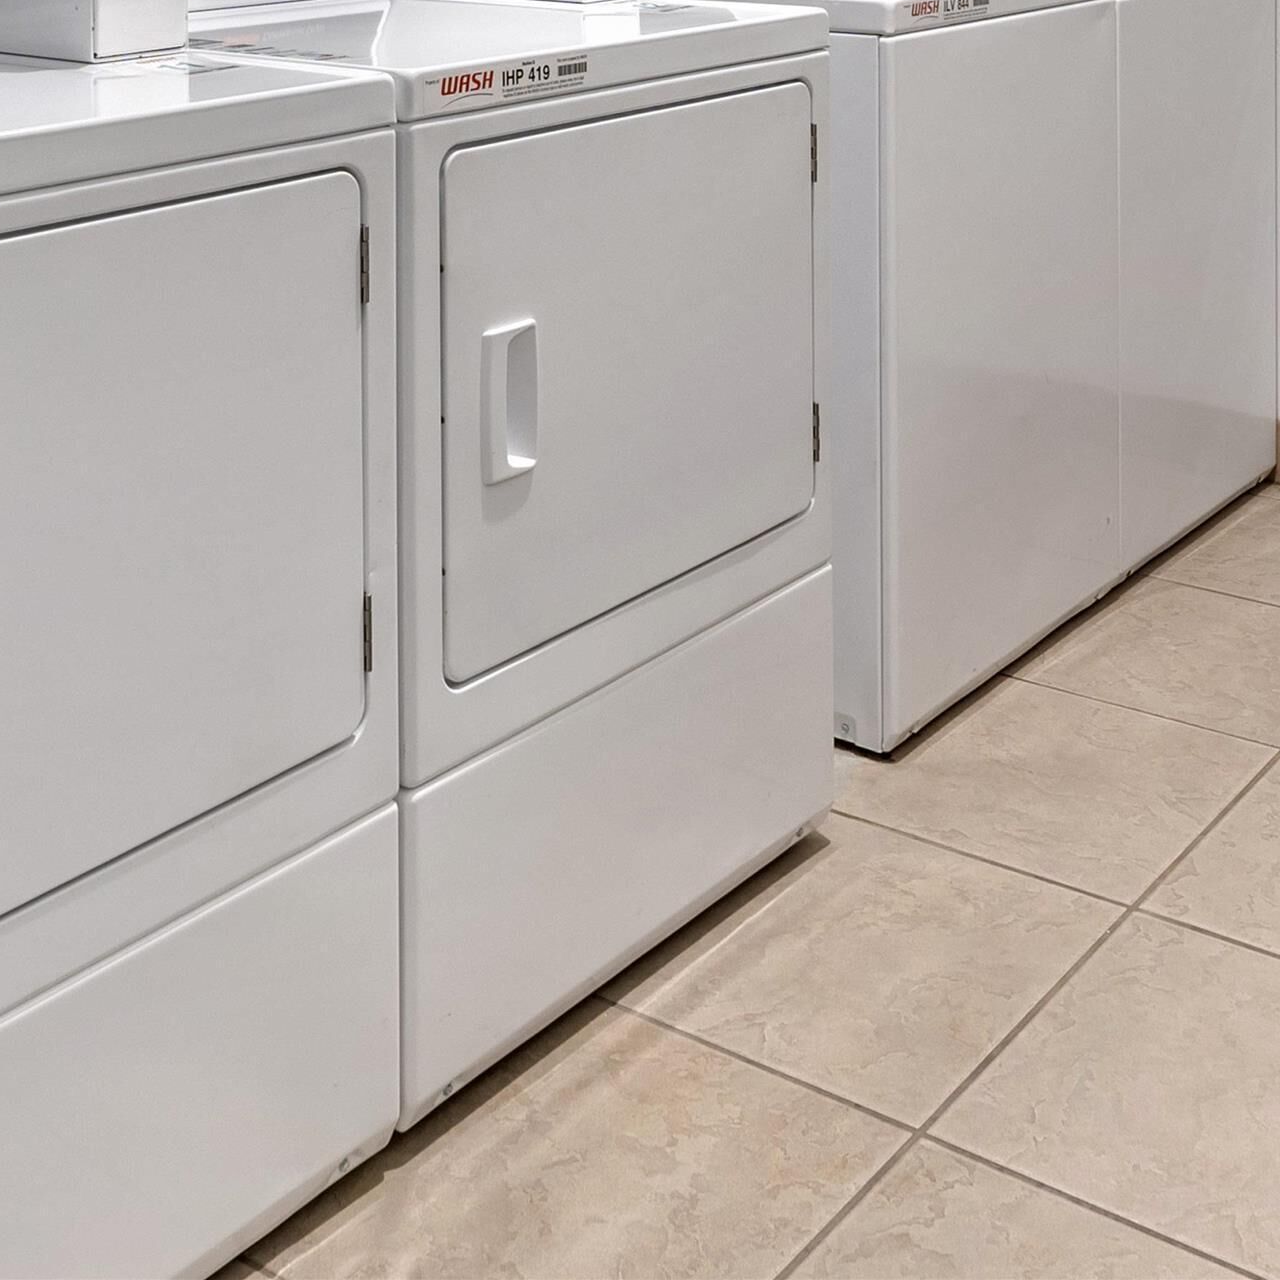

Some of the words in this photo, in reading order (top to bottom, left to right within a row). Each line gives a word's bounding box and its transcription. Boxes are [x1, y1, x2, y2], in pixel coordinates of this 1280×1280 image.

[912, 0, 939, 16] WASH
[441, 70, 494, 96] WASH
[502, 69, 524, 87] IHP
[528, 65, 550, 82] 419
